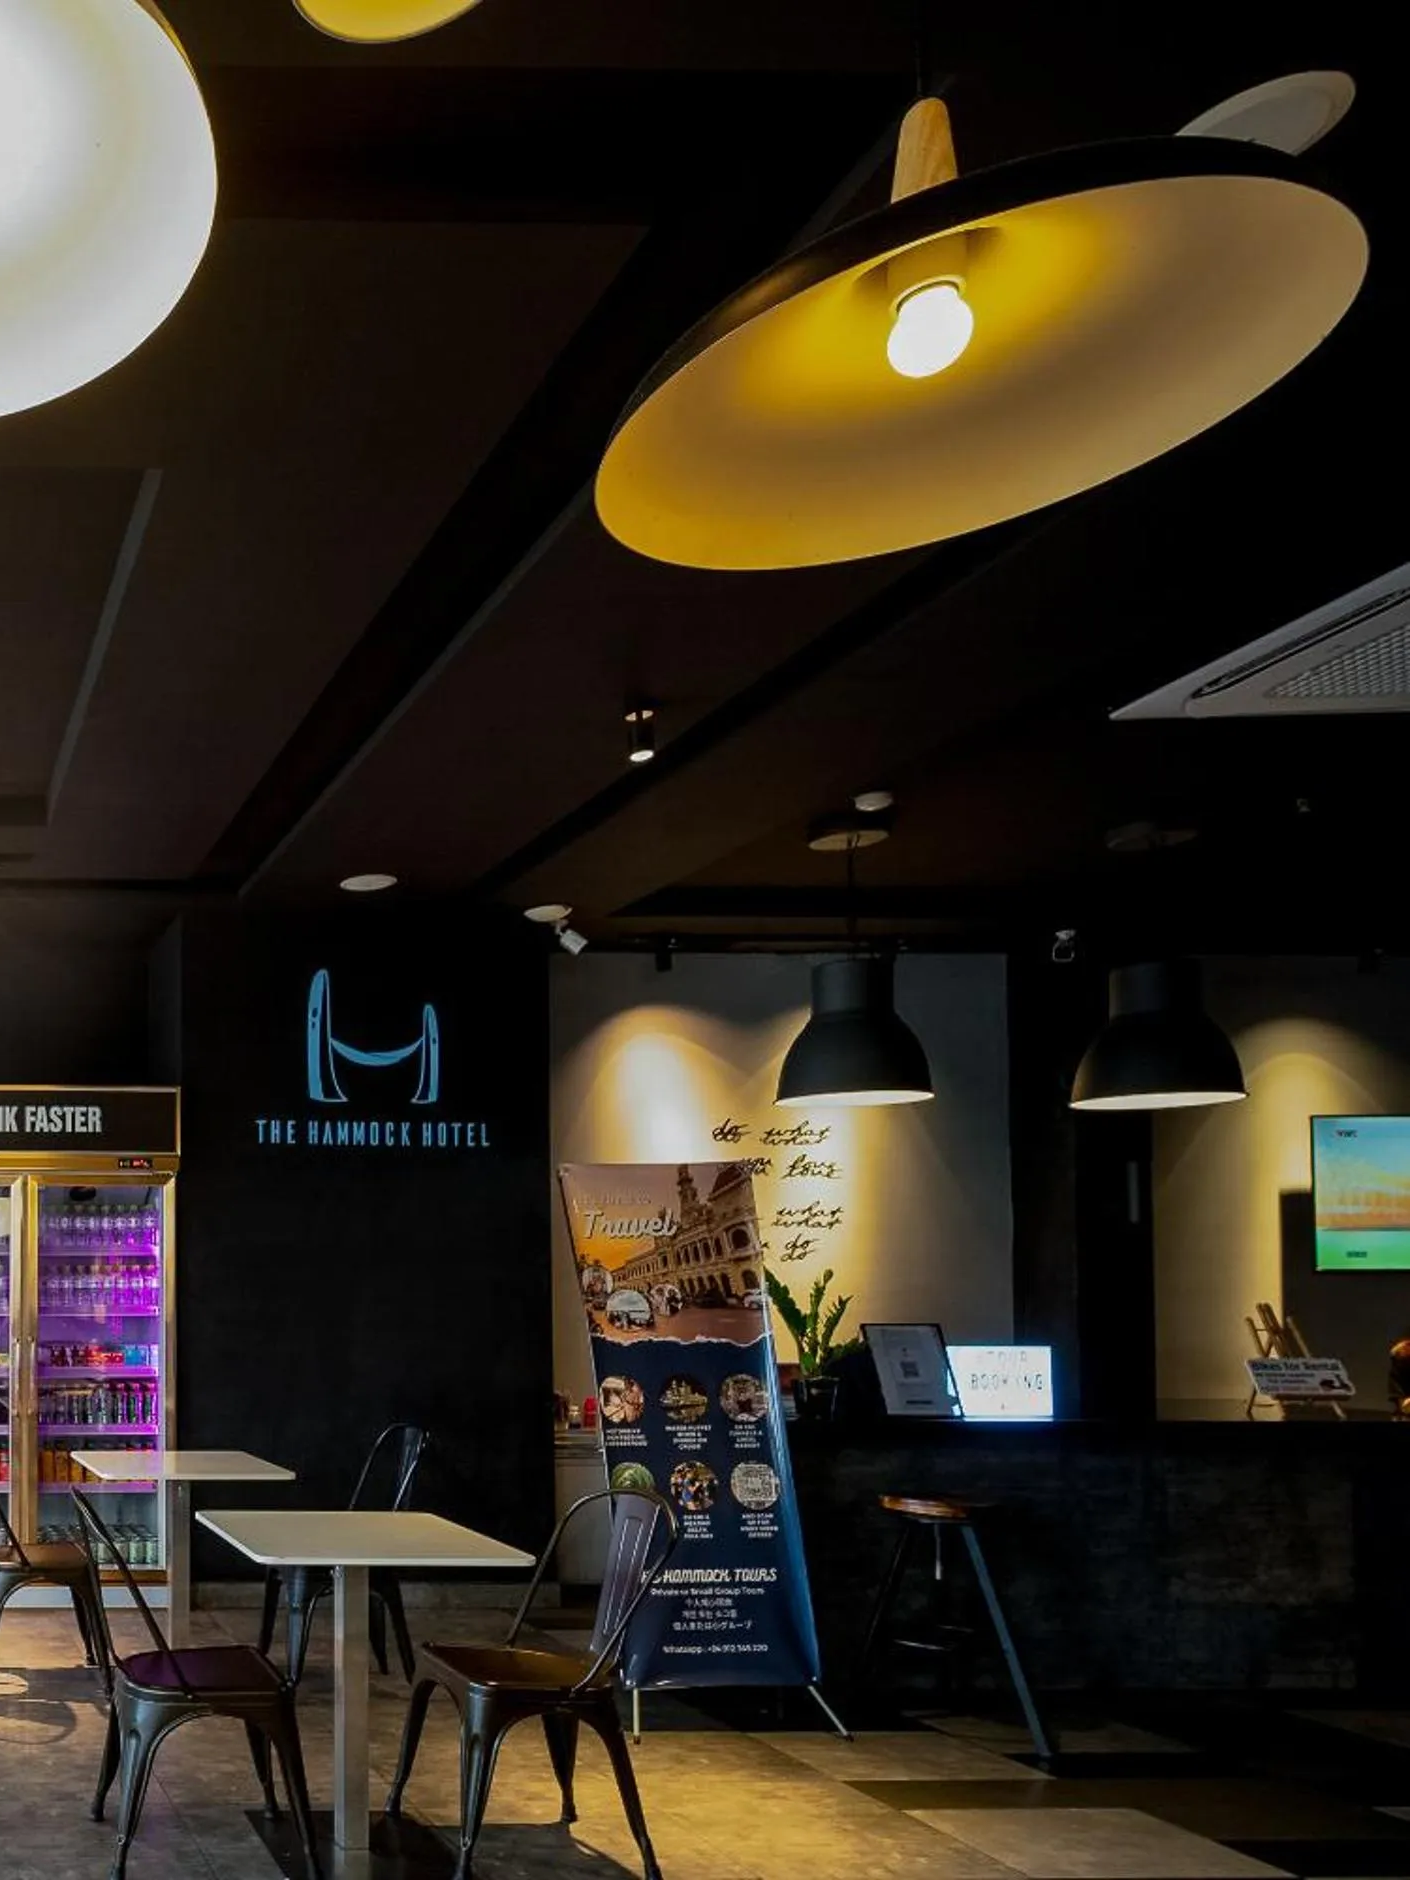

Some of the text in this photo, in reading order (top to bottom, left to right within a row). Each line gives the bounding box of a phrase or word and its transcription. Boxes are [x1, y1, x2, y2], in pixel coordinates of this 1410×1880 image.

[24, 1105, 103, 1133] FASTER
[255, 1119, 491, 1147] THE HAMMOCK HOTEL
[763, 1120, 831, 1140] what
[775, 1201, 844, 1221] what
[784, 1233, 821, 1252] do
[970, 1373, 1043, 1391] BOONG
[663, 1568, 732, 1583] HAMMOCK
[734, 1567, 778, 1583] TOURS
